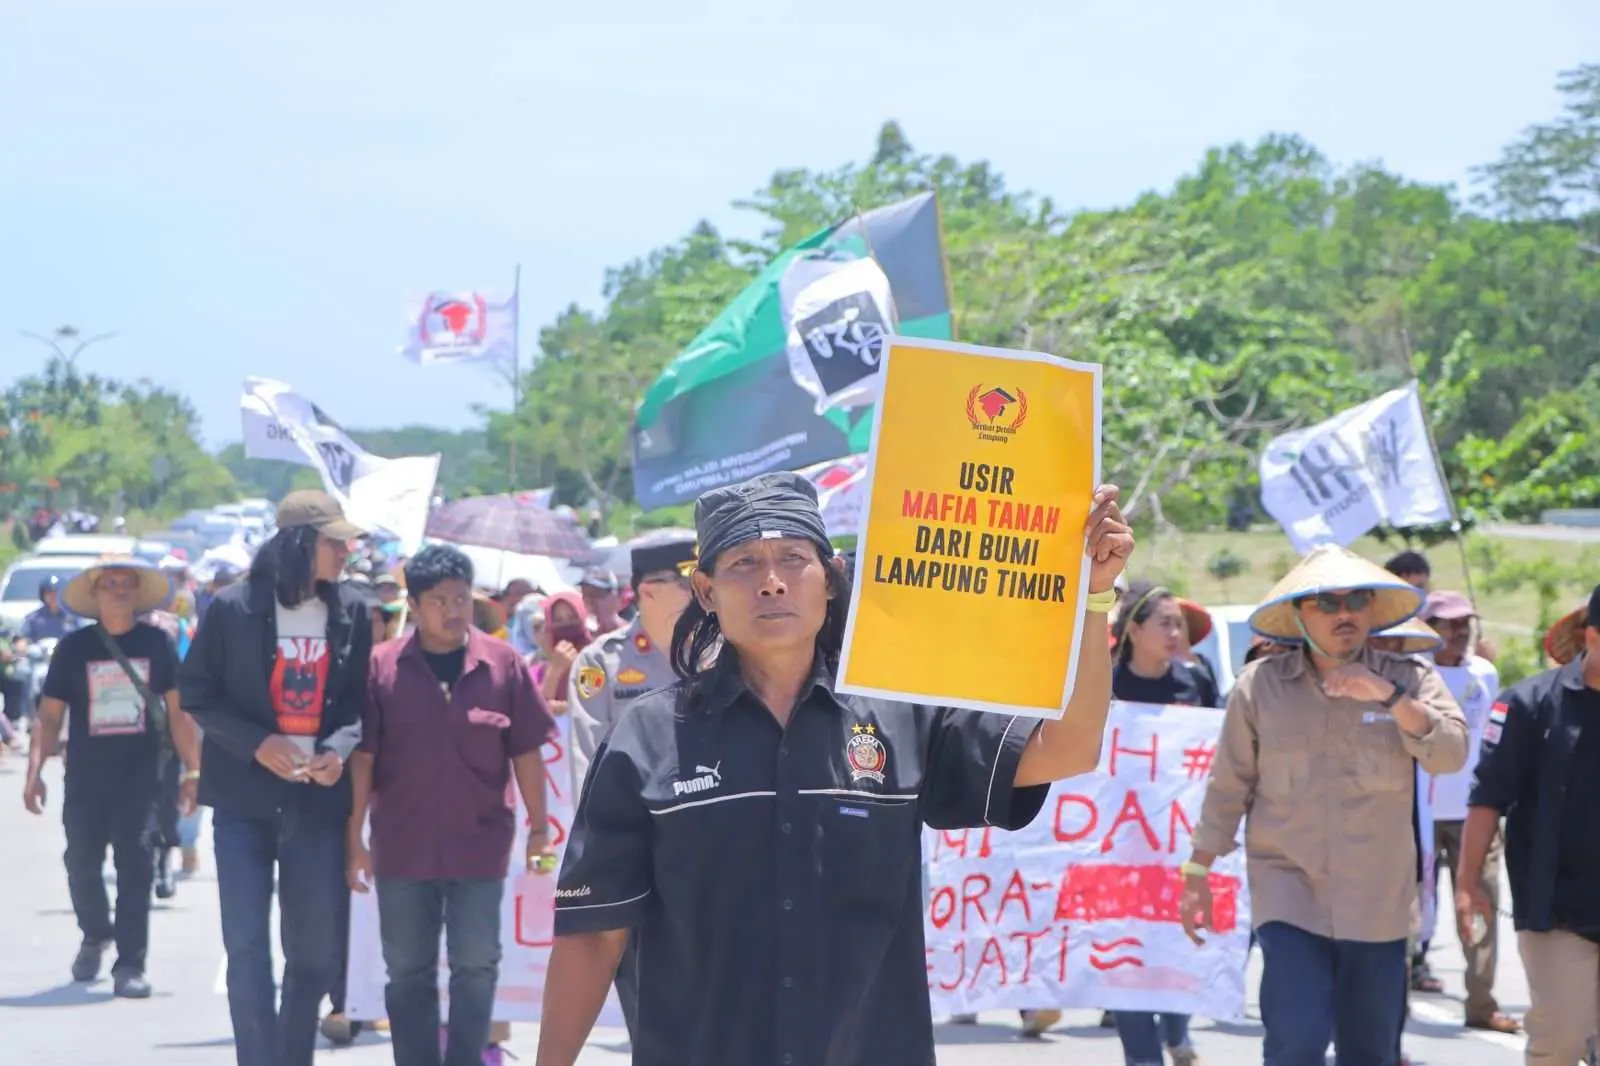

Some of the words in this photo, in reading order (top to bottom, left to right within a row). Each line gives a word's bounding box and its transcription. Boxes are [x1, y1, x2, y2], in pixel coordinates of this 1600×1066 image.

[959, 461, 1015, 495] USIR
[902, 489, 977, 526] MAFIA
[988, 499, 1061, 535] TANAH
[915, 524, 971, 560] DARI
[979, 532, 1039, 567] BUMI
[874, 554, 989, 595] LAMPUNG
[996, 569, 1067, 603] TIMUR
